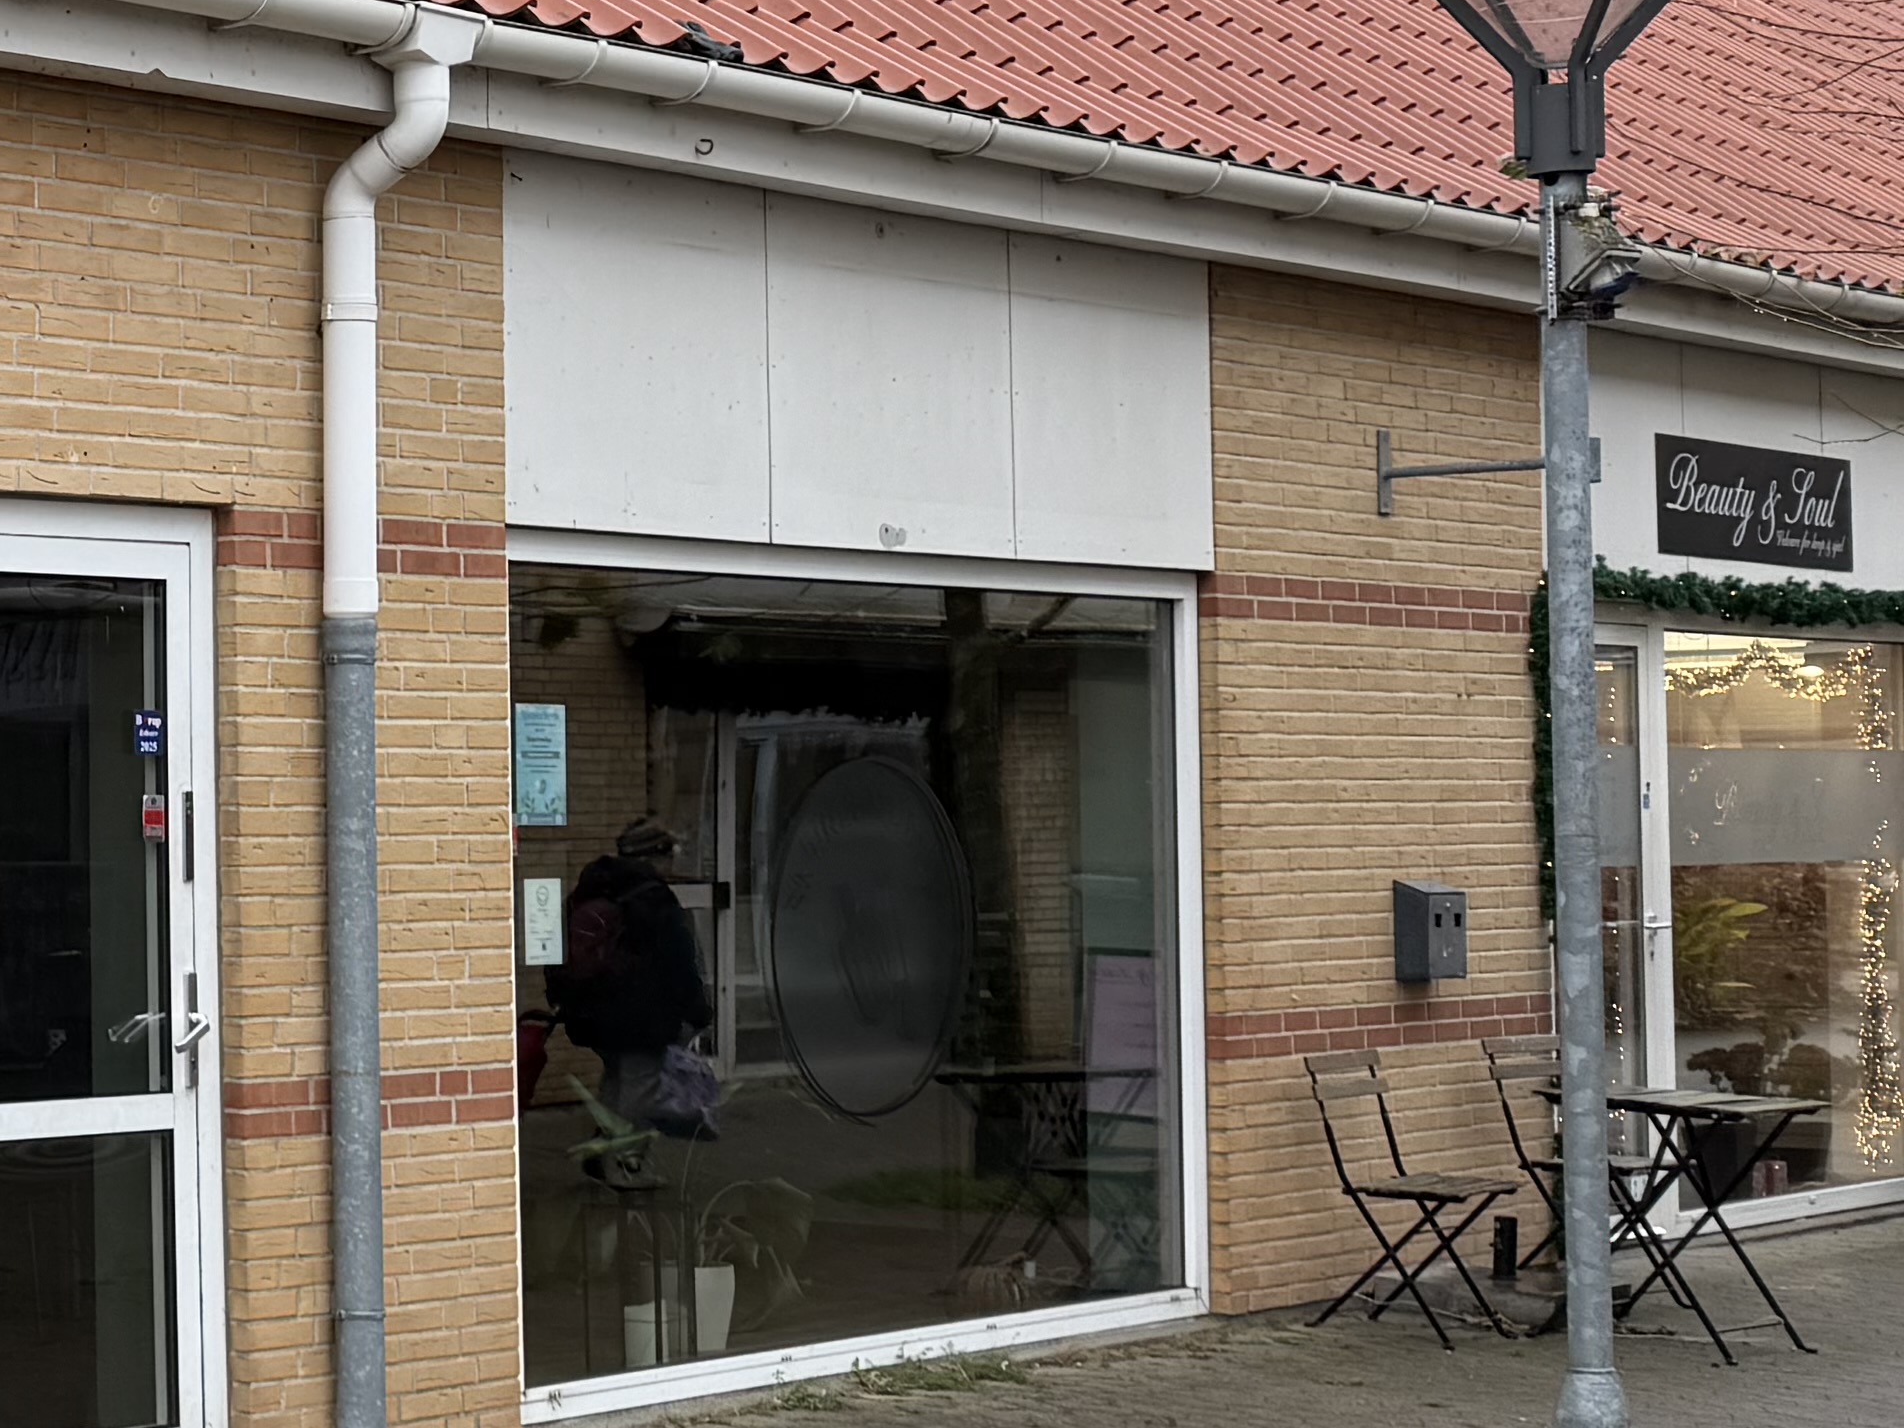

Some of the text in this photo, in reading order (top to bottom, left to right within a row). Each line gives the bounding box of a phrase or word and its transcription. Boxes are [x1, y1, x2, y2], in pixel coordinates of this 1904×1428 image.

[1666, 453, 1844, 547] Beauty & Soul
